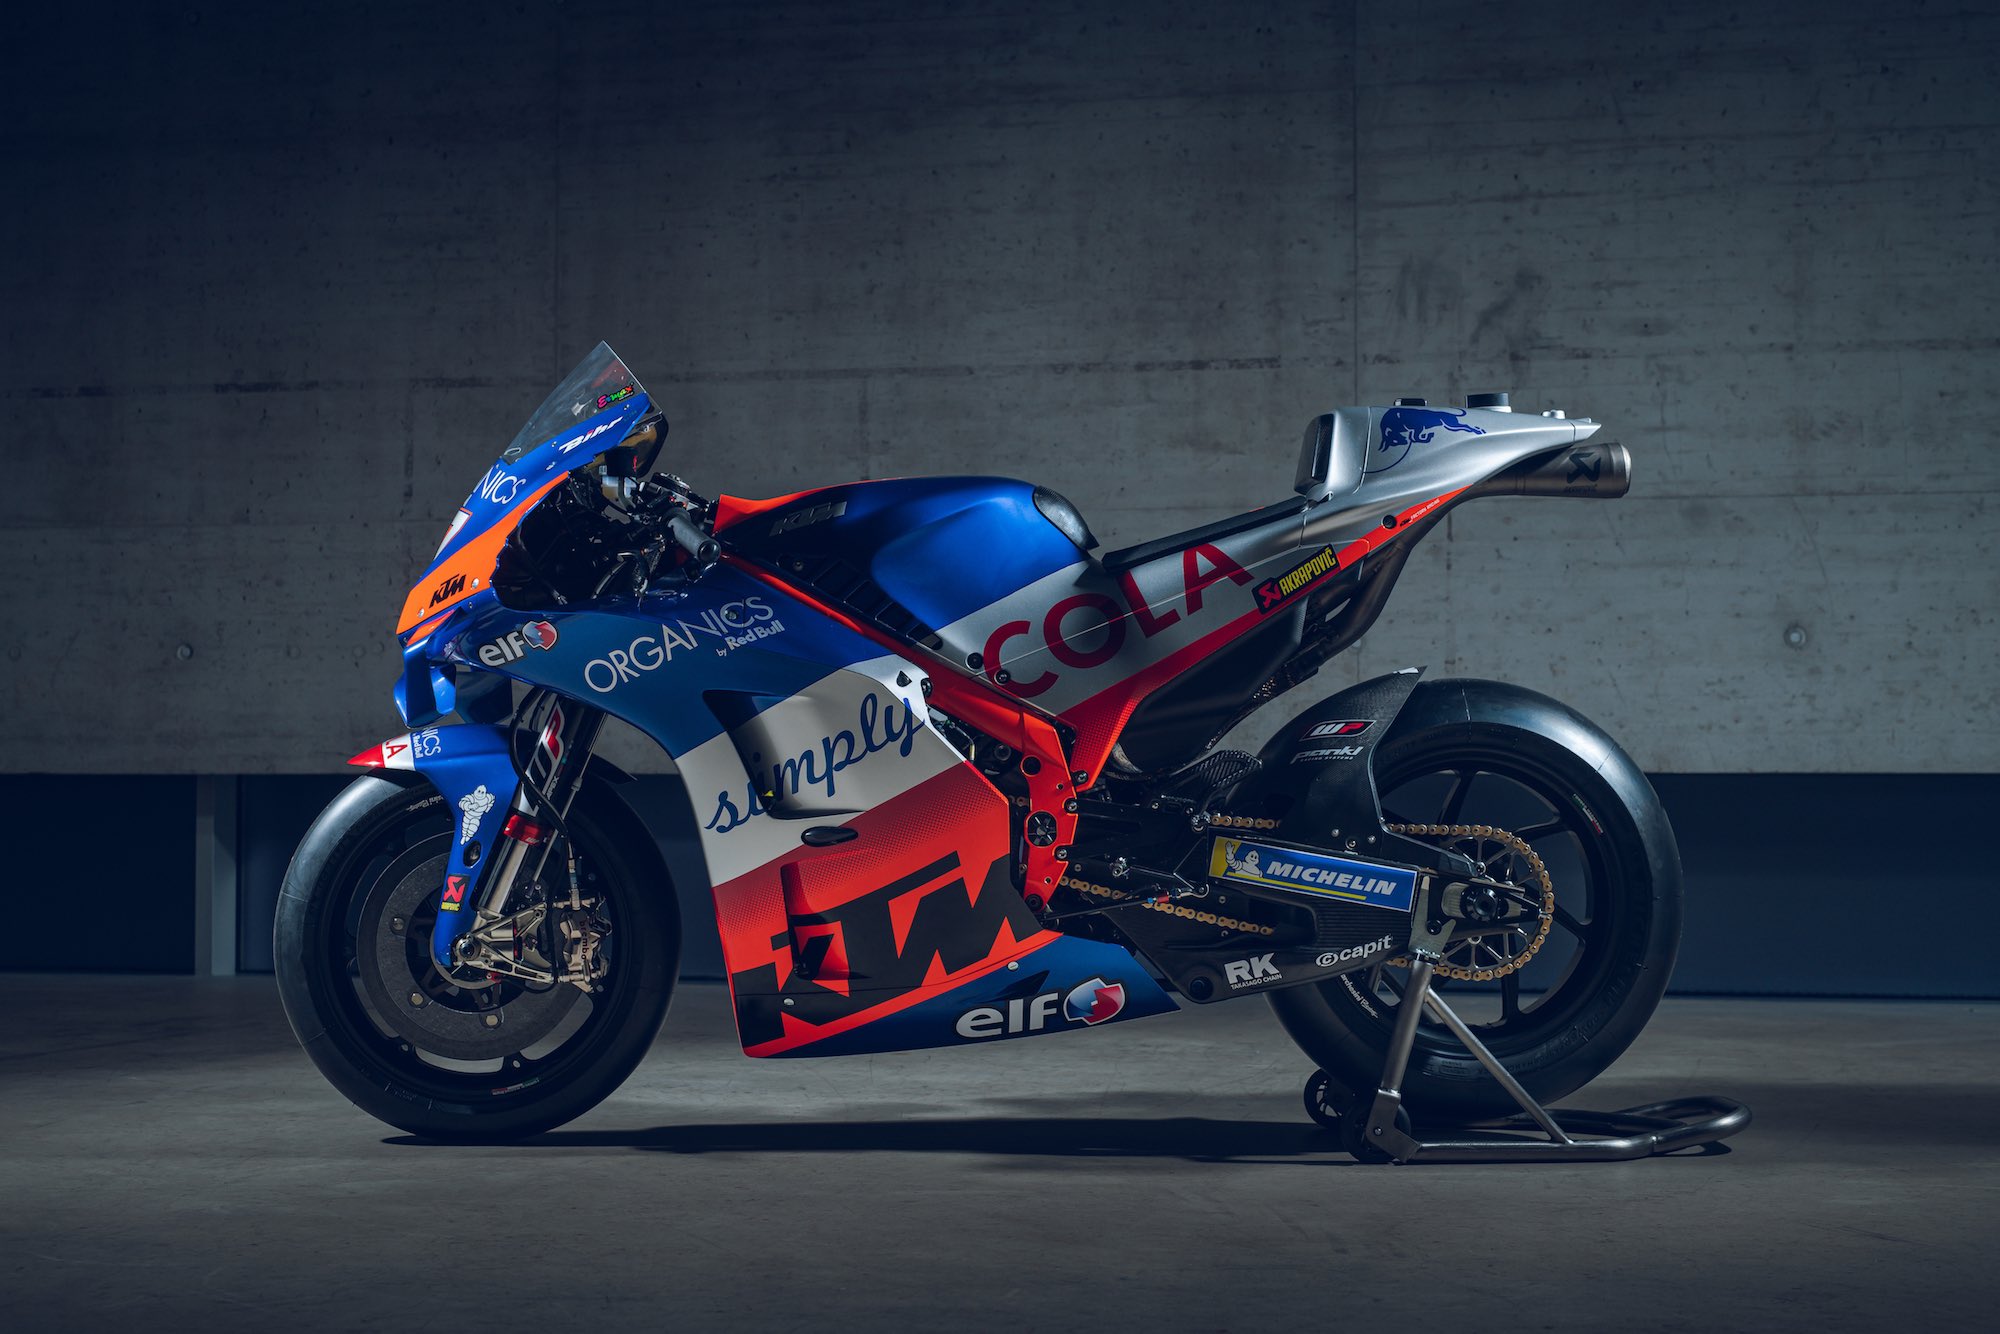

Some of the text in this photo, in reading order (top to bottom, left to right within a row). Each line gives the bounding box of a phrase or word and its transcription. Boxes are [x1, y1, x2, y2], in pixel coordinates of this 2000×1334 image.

[559, 416, 623, 454] Bihr
[1278, 547, 1336, 596] AKRAPOVIČ
[429, 574, 467, 609] KTM
[716, 620, 785, 656] by Red Bull
[983, 543, 1255, 698] COLA
[479, 631, 525, 667] elf
[584, 596, 774, 693] ORGANICS
[703, 693, 926, 834] simply
[1290, 746, 1364, 765] pankl
[1265, 861, 1397, 896] MICHELIN
[732, 850, 1043, 1048] KTM
[1224, 953, 1280, 984] RK
[1231, 973, 1283, 990] TAKASAGO CHAIN
[956, 992, 1058, 1038] elf
